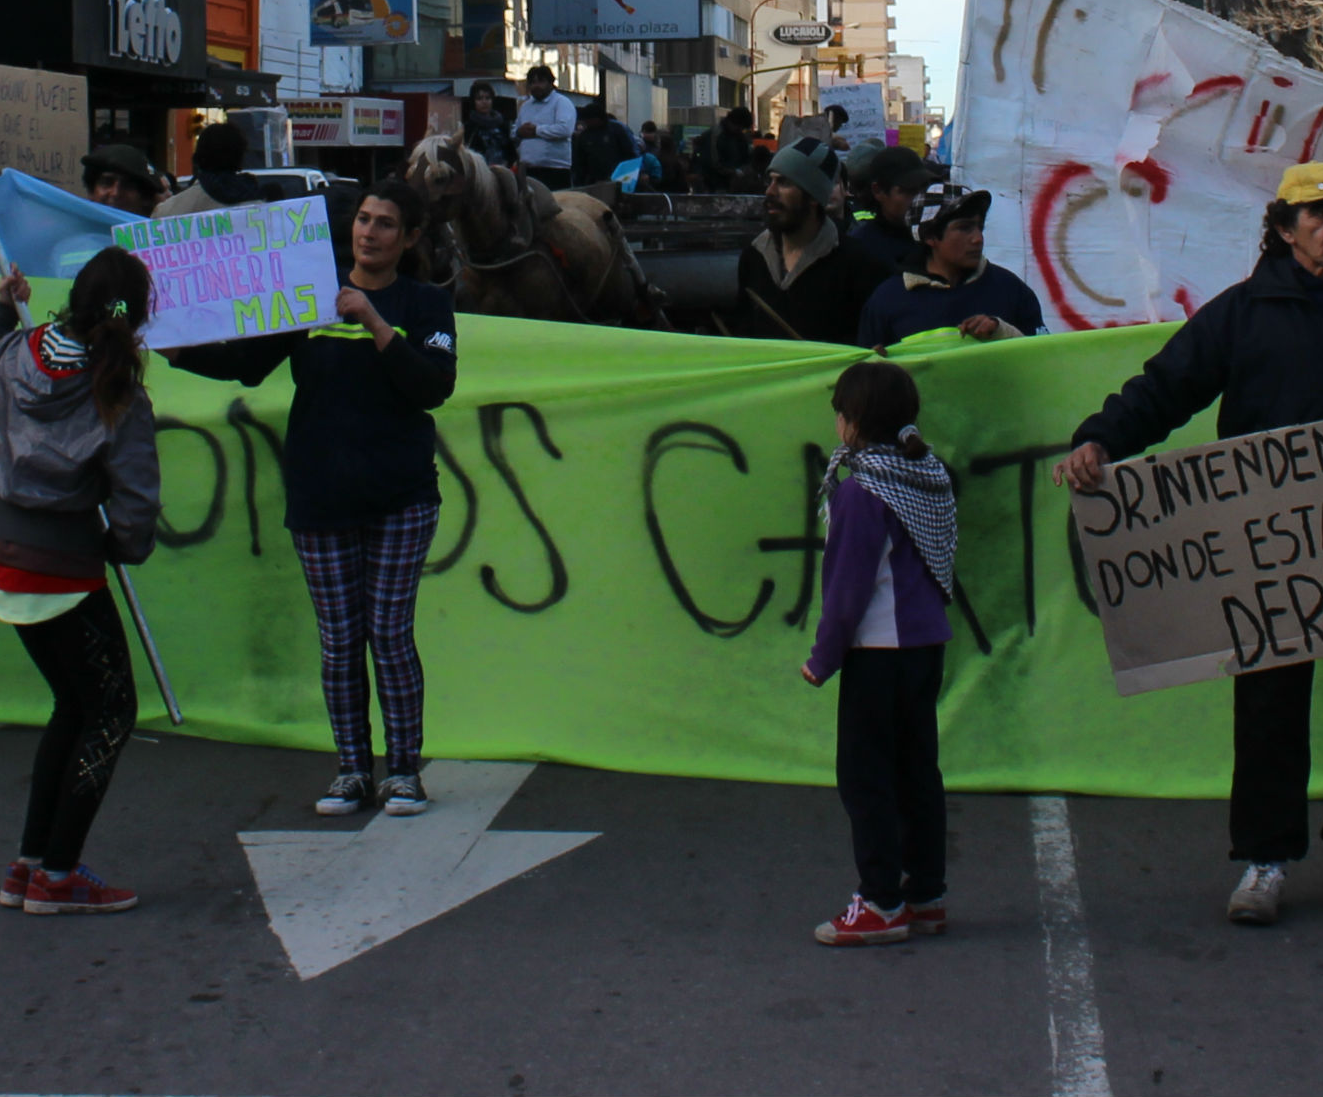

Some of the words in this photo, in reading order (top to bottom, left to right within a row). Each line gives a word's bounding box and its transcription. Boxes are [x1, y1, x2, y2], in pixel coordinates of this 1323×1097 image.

[639, 21, 679, 36] plaza
[246, 202, 312, 252] SOY
[301, 221, 331, 245] UN
[134, 234, 248, 272] SOCUPADO
[233, 283, 320, 335] MAS
[1097, 530, 1235, 608] DONDE
